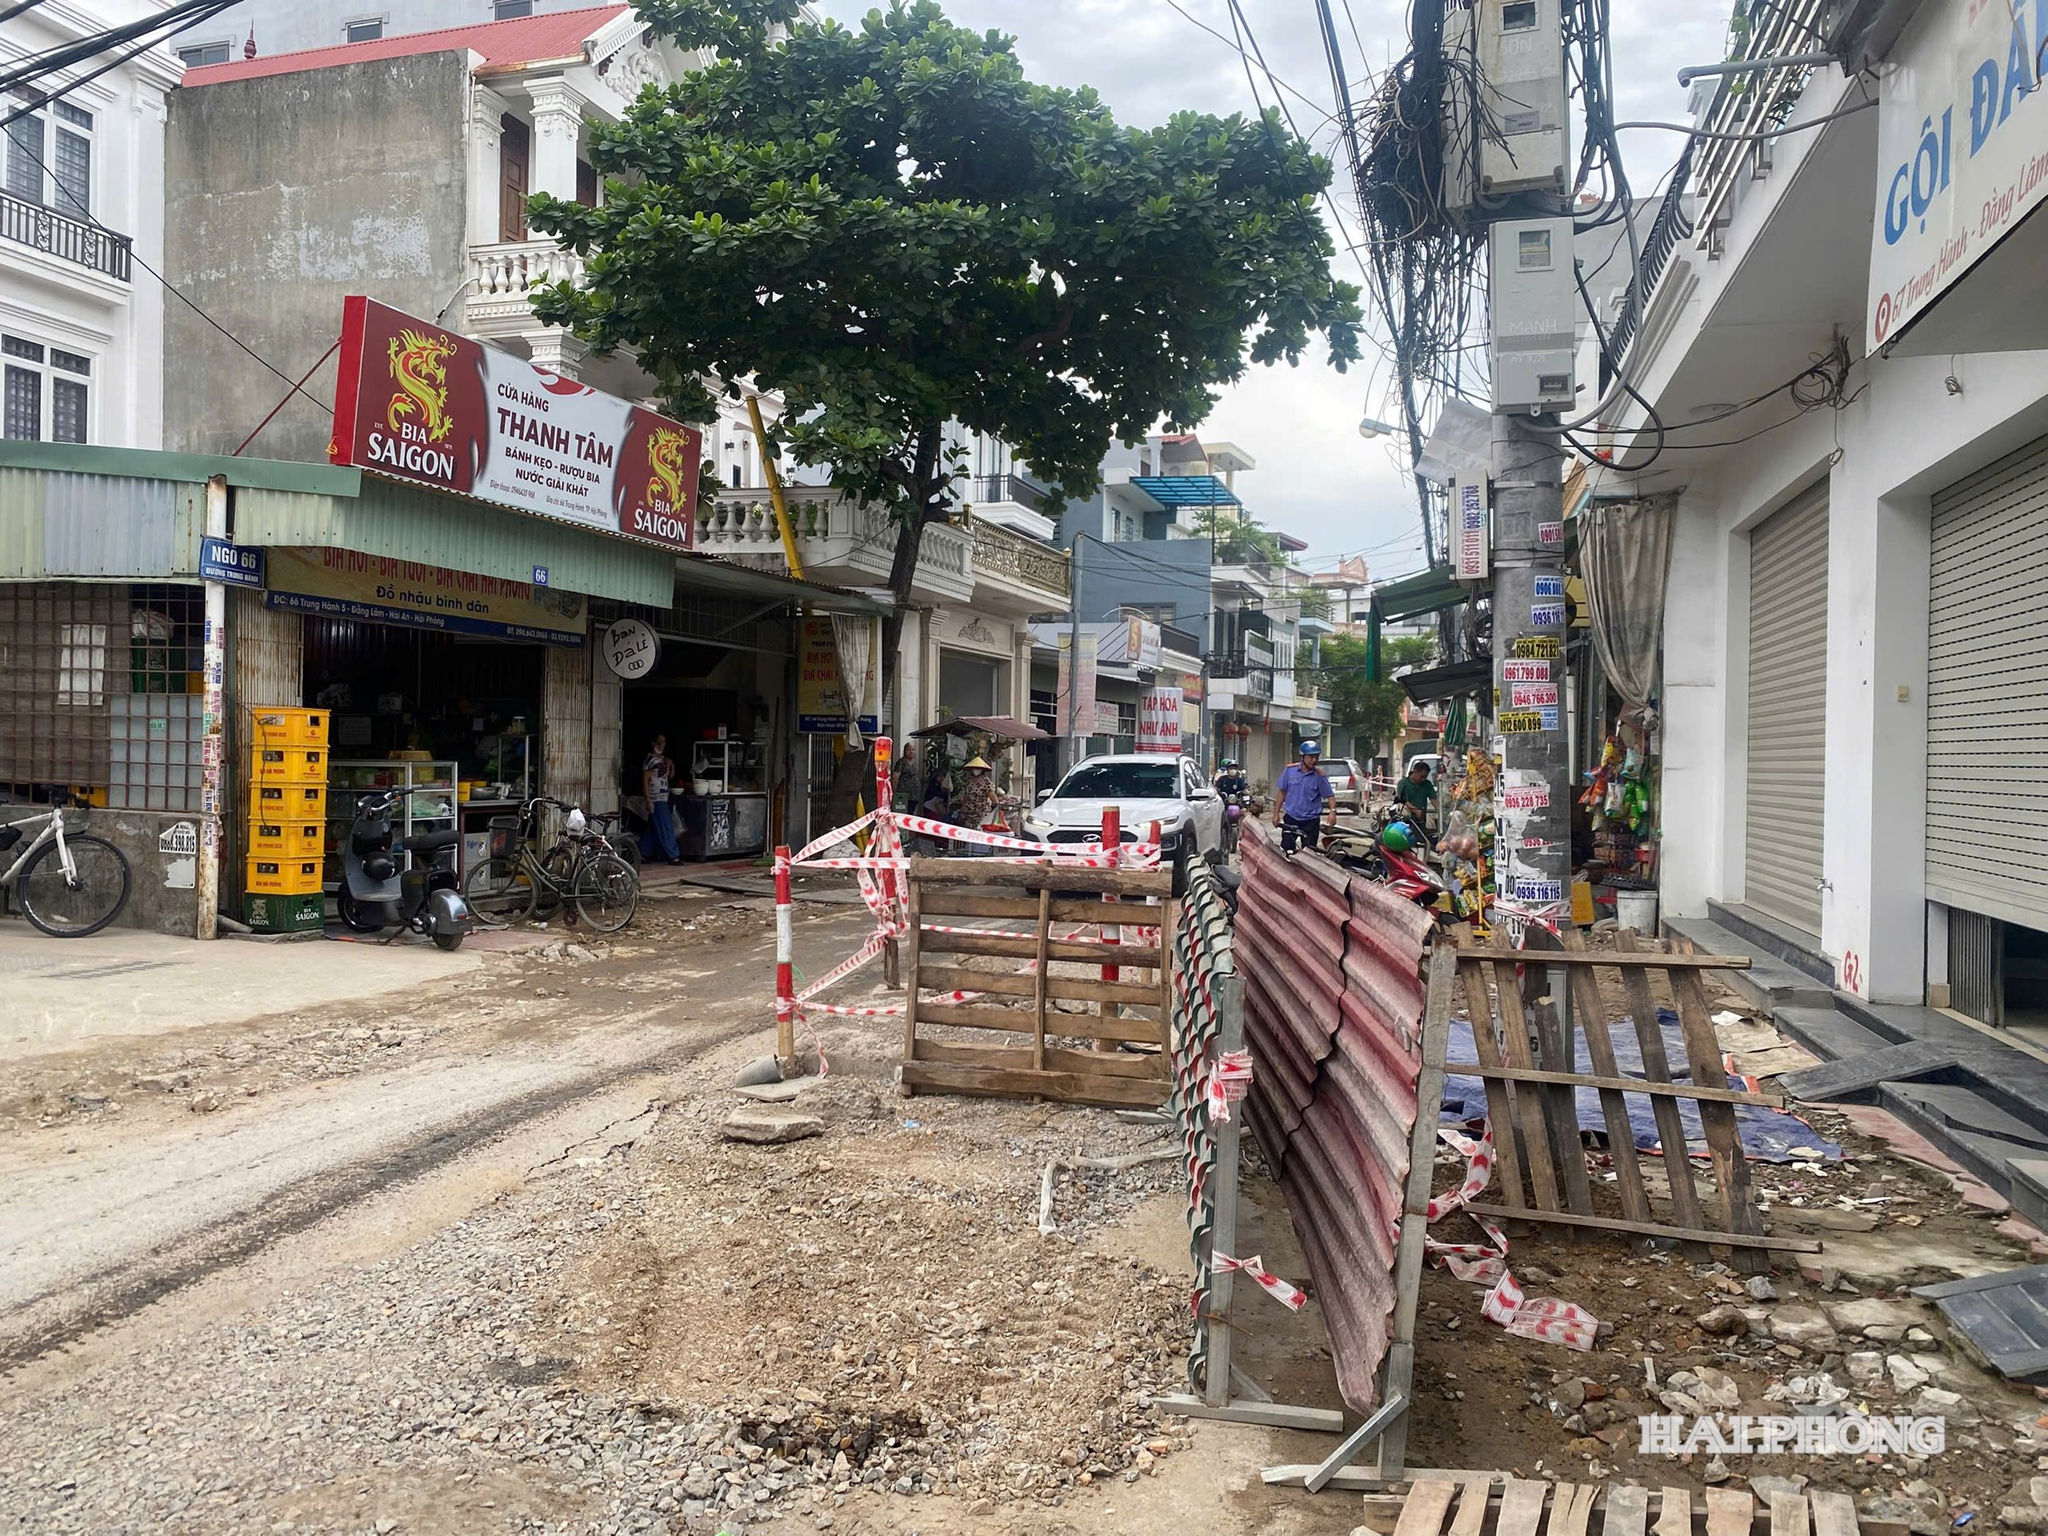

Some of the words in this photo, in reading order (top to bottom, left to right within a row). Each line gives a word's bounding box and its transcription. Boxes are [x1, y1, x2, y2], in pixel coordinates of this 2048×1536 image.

[1884, 104, 1953, 246] GỘI
[1892, 284, 1906, 322] 67
[1907, 264, 1936, 309] Trung
[1936, 225, 1967, 283] Hành
[1979, 184, 2015, 239] Đằng
[497, 383, 518, 402] CỬA
[521, 391, 549, 412] HÀNG
[401, 422, 427, 445] BIA
[497, 407, 570, 455] THANH
[575, 432, 614, 468] TÂM
[367, 432, 454, 481] SAIGON
[505, 446, 533, 464] BÁNH
[534, 456, 553, 470] KẸO
[560, 463, 585, 480] RƯỢU
[587, 470, 600, 484] BIA
[516, 468, 544, 485] NƯỚC
[546, 477, 564, 490] GIẢI
[566, 483, 589, 497] KHÁT
[655, 499, 670, 515] BIA
[634, 508, 687, 542] SAIGON
[212, 545, 238, 565] NGÕ
[241, 552, 256, 569] 66
[535, 569, 545, 582] 66
[290, 597, 299, 606] 66
[300, 598, 319, 611] Trung
[322, 600, 340, 612] Hành
[351, 603, 369, 618] Đằng
[371, 607, 384, 618] Lâm
[389, 610, 400, 620] Hải
[401, 613, 410, 621] An
[414, 613, 424, 623] Hải
[426, 616, 445, 627] Phòng
[376, 584, 395, 600] Đồ
[400, 590, 432, 607] nhậu
[437, 595, 462, 610] bình
[467, 600, 489, 613] dân
[1139, 721, 1158, 736] NHƯ
[1160, 721, 1178, 736] ANH
[1516, 886, 1560, 900] 0936.116.115
[249, 918, 269, 926] SAIGON
[295, 912, 320, 921] SAIGON
